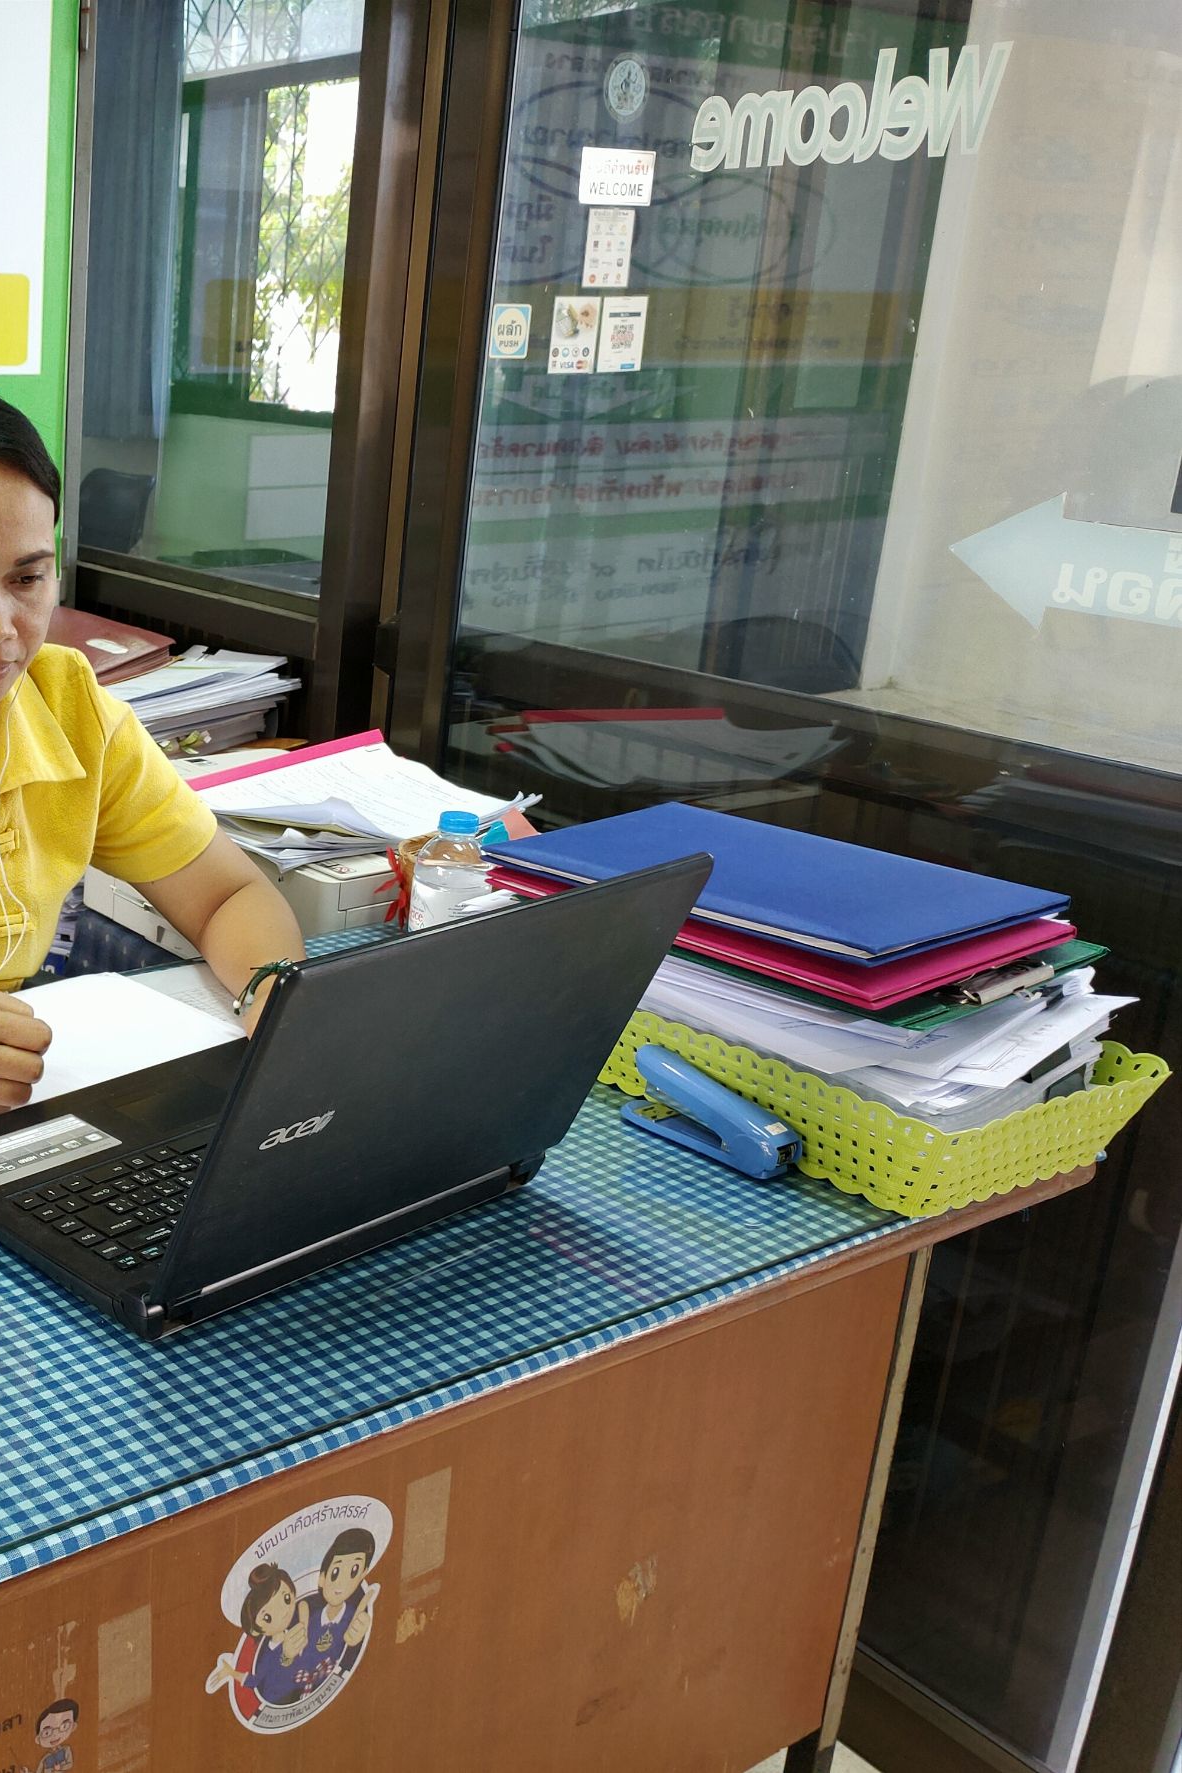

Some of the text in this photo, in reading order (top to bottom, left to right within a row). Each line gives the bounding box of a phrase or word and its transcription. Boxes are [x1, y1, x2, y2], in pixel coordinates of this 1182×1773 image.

[589, 182, 644, 197] WELCOME
[497, 320, 522, 337] ผลัก
[258, 1110, 336, 1150] acer
[253, 1502, 372, 1560] พัฒนาคือสร้างสรรค์
